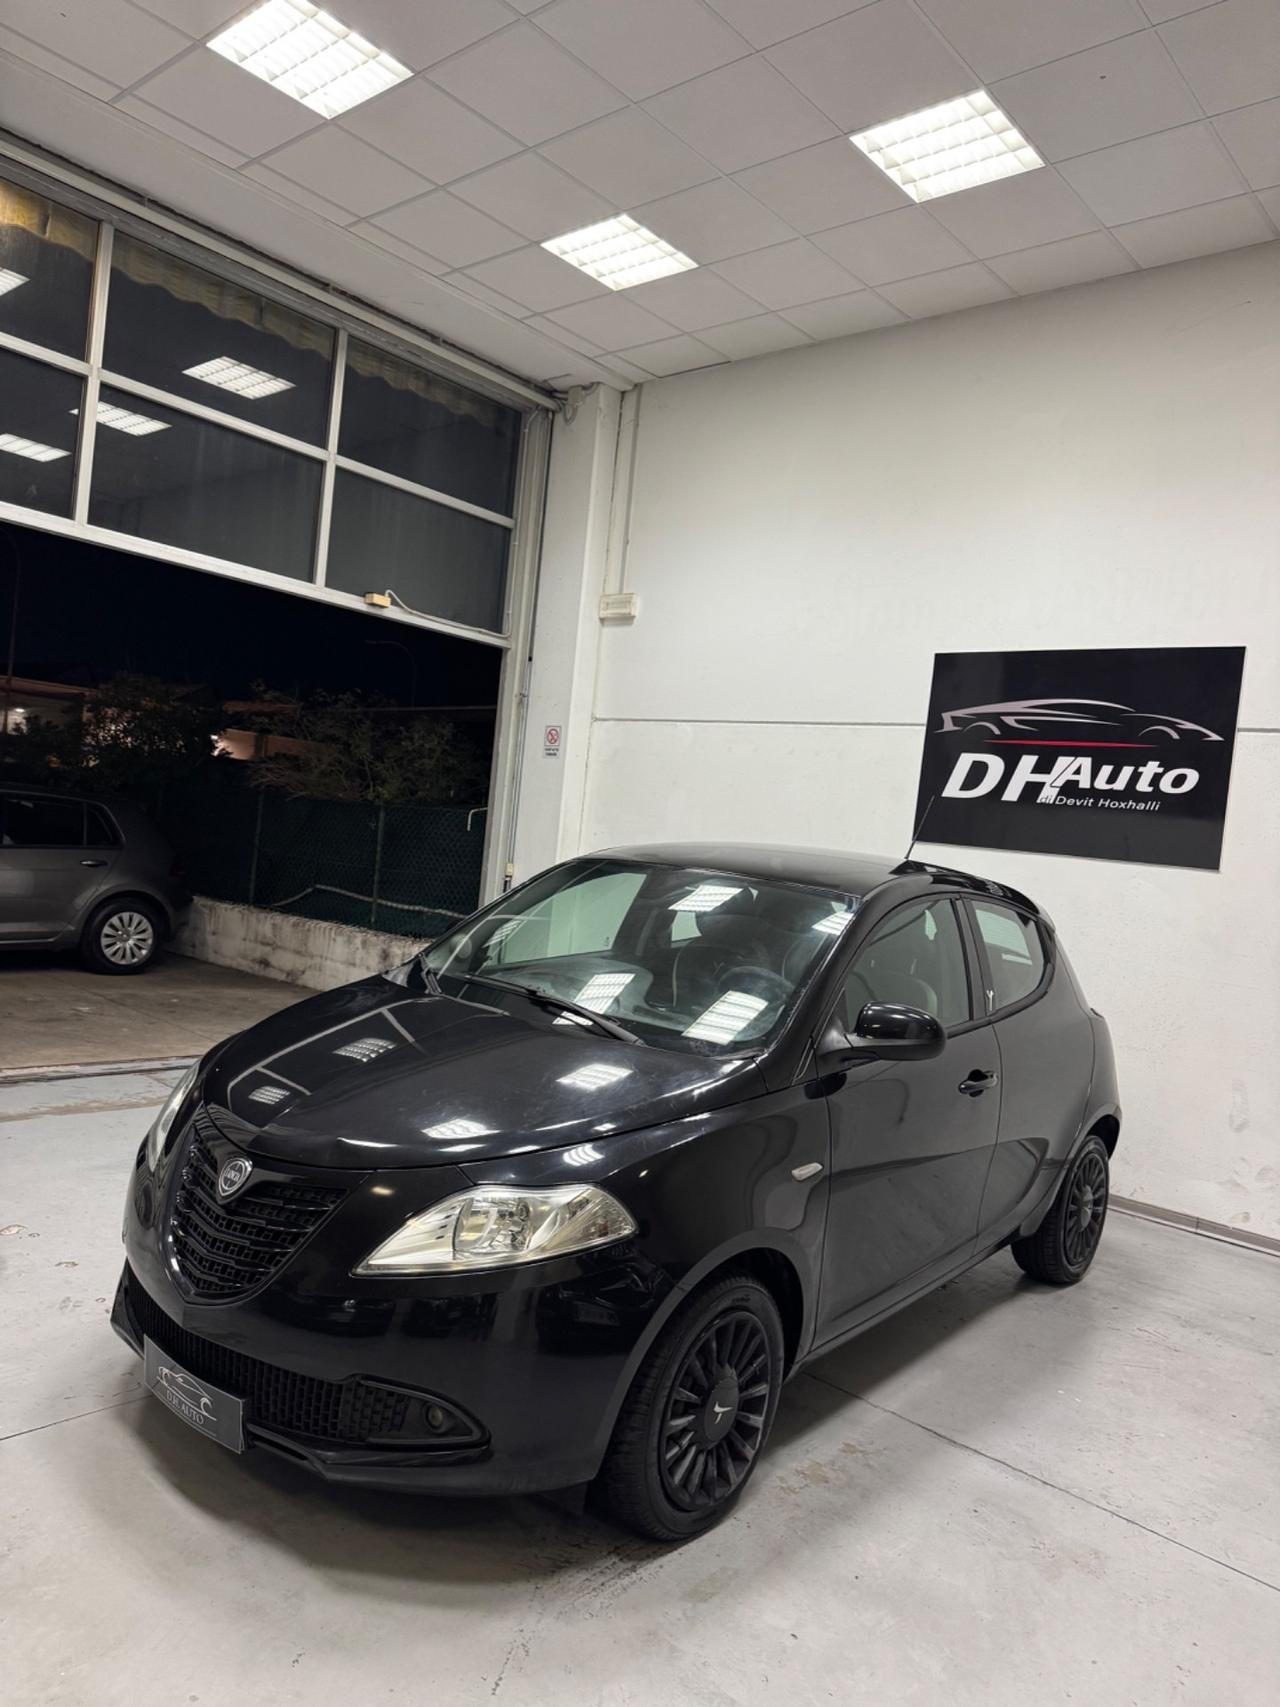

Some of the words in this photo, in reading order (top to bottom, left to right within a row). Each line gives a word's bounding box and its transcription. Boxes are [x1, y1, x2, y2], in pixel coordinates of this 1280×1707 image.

[1055, 795, 1094, 807] Devit
[1098, 798, 1161, 811] Hoxhalli
[181, 1403, 204, 1425] AUTO
